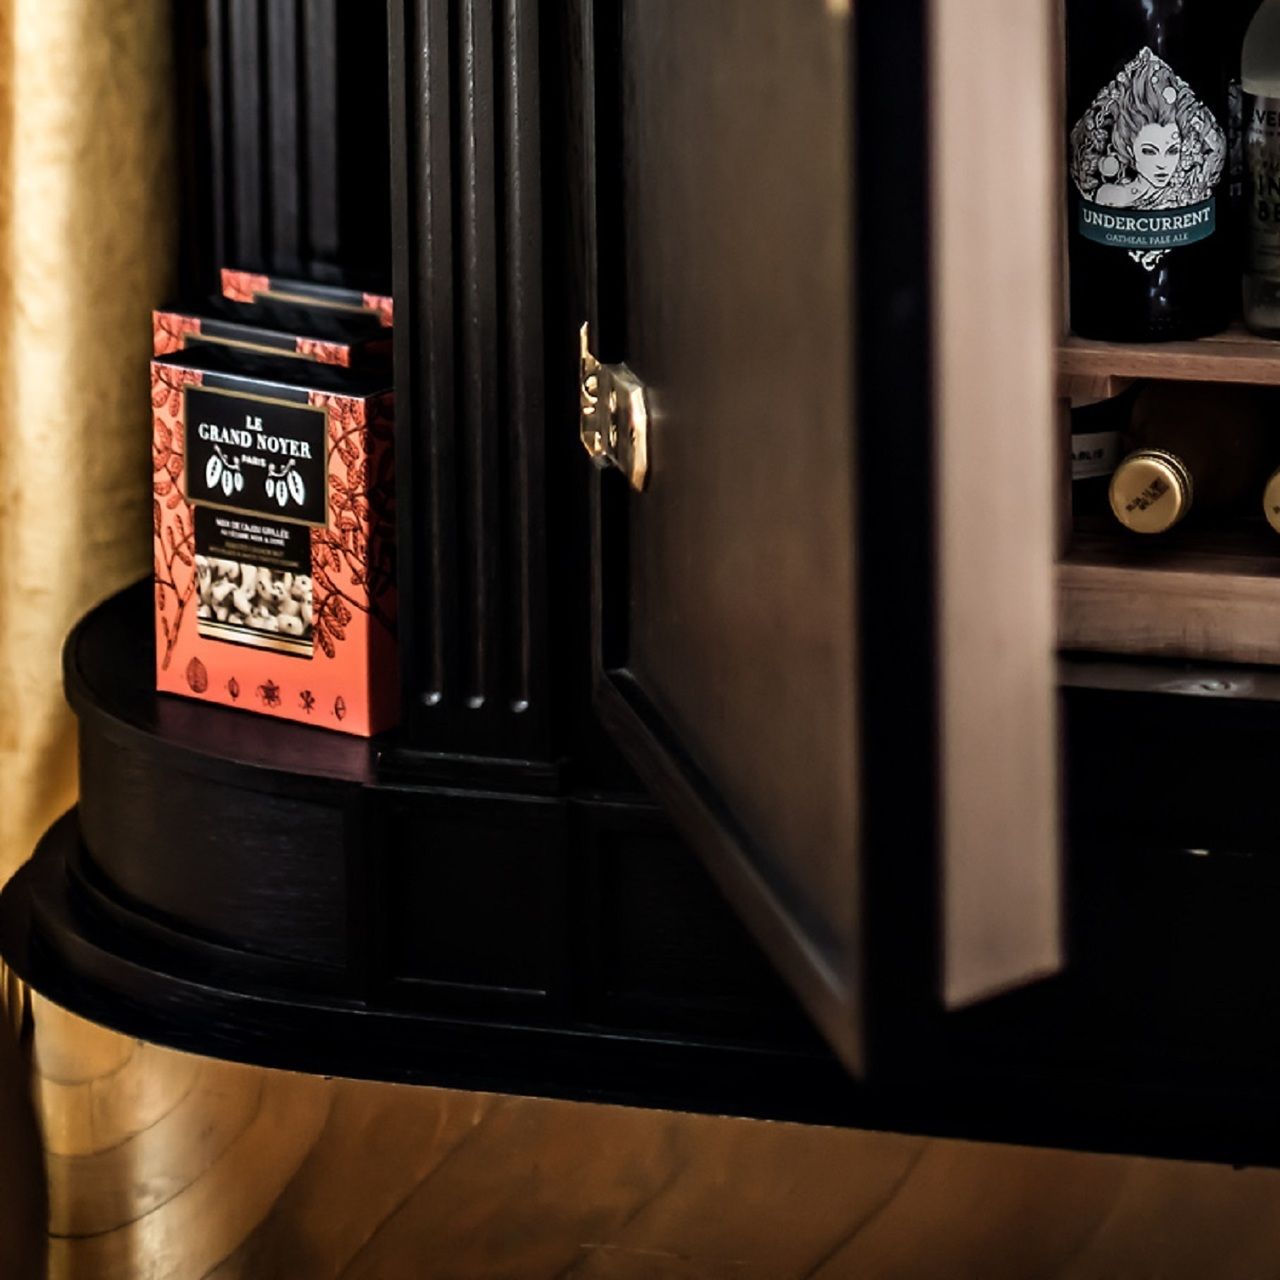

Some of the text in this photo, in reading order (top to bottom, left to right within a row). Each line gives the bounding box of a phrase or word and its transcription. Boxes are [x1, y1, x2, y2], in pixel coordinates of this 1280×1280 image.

[1082, 207, 1211, 232] UNDERCURRENT
[1149, 233, 1171, 245] PALE
[1173, 232, 1189, 242] ALE
[245, 414, 264, 432] LE
[198, 422, 313, 459] GRAND NOYER
